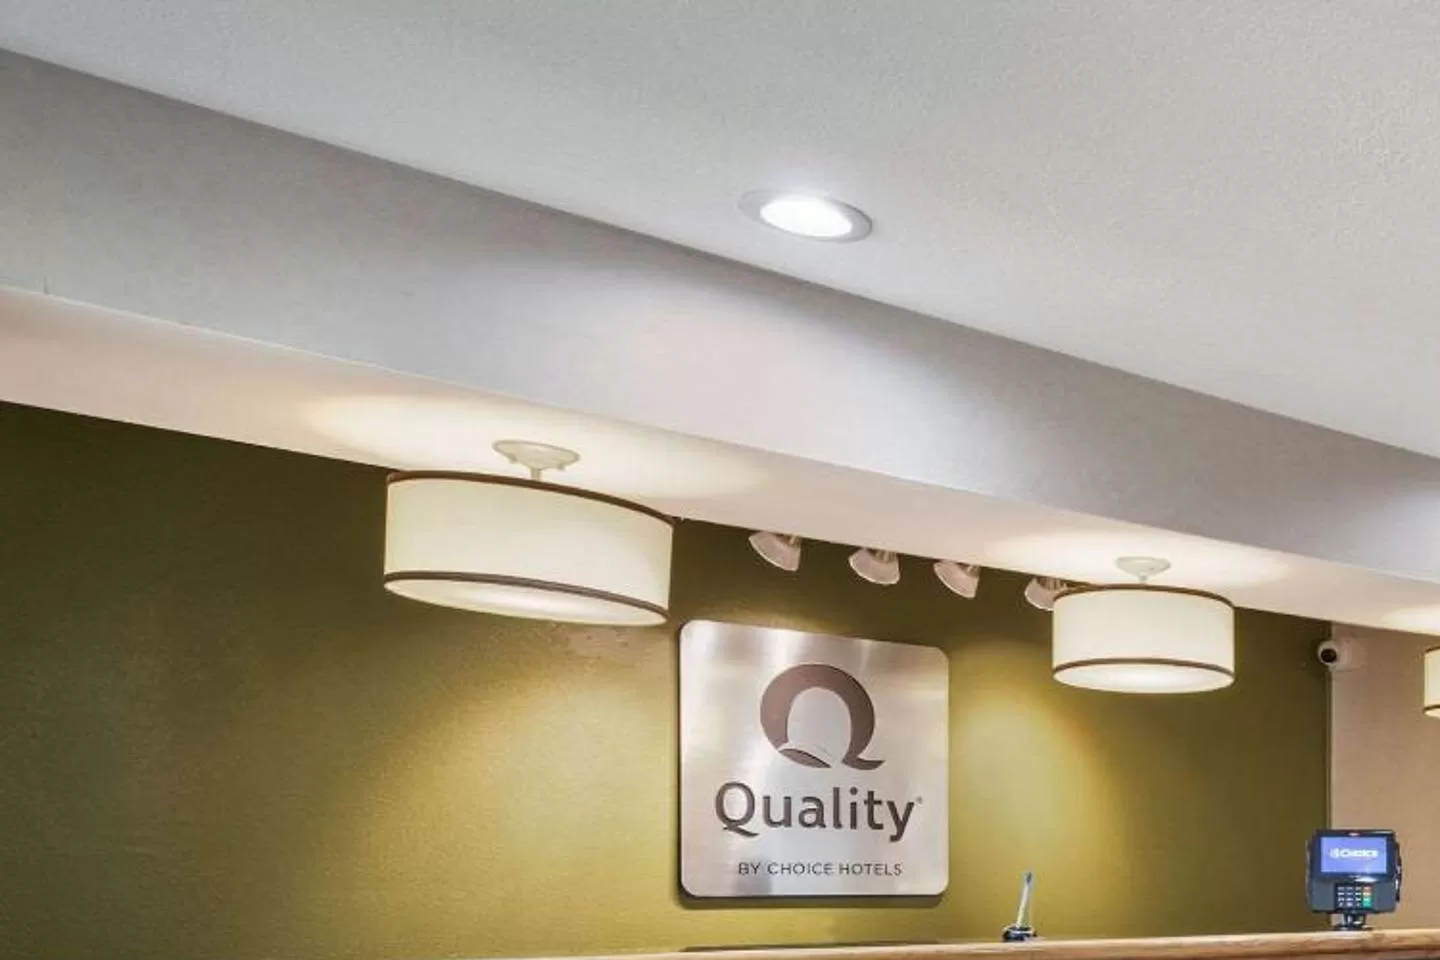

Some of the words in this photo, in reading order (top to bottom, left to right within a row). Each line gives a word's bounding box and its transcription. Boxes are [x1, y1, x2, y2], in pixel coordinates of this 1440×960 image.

[759, 663, 885, 771] Q
[715, 781, 916, 843] Quality
[738, 862, 761, 876] BY
[767, 862, 833, 876] CHOICE
[839, 863, 902, 877] HOTELS
